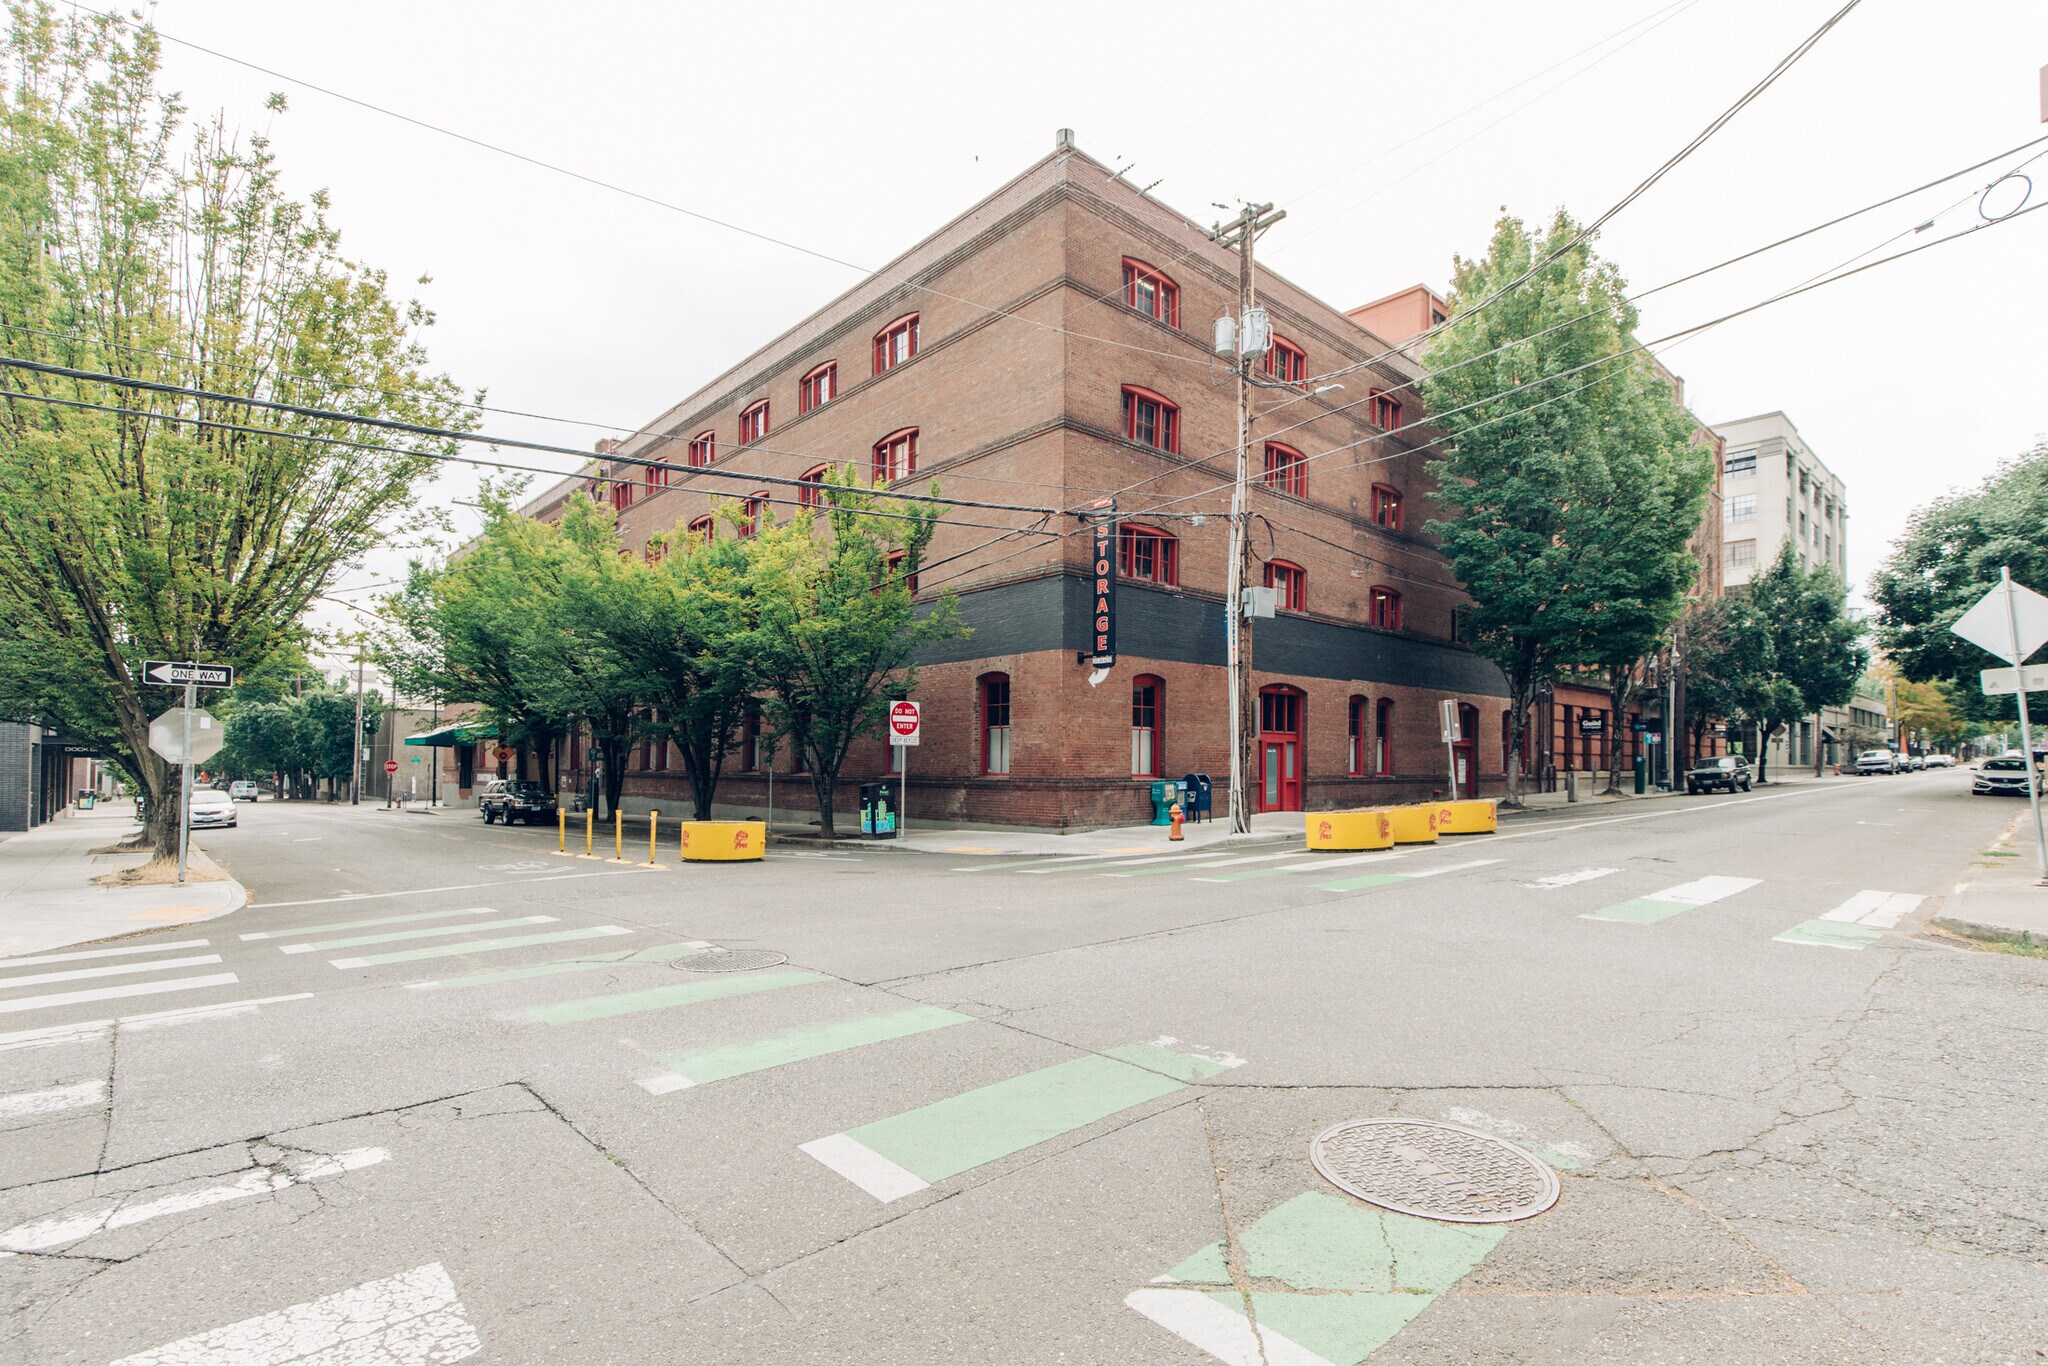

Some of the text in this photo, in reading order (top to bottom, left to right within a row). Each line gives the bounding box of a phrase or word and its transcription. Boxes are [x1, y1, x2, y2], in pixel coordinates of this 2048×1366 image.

[1096, 523, 1110, 651] STORAGE
[171, 669, 223, 680] ONE WAY
[896, 722, 913, 730] ENTER
